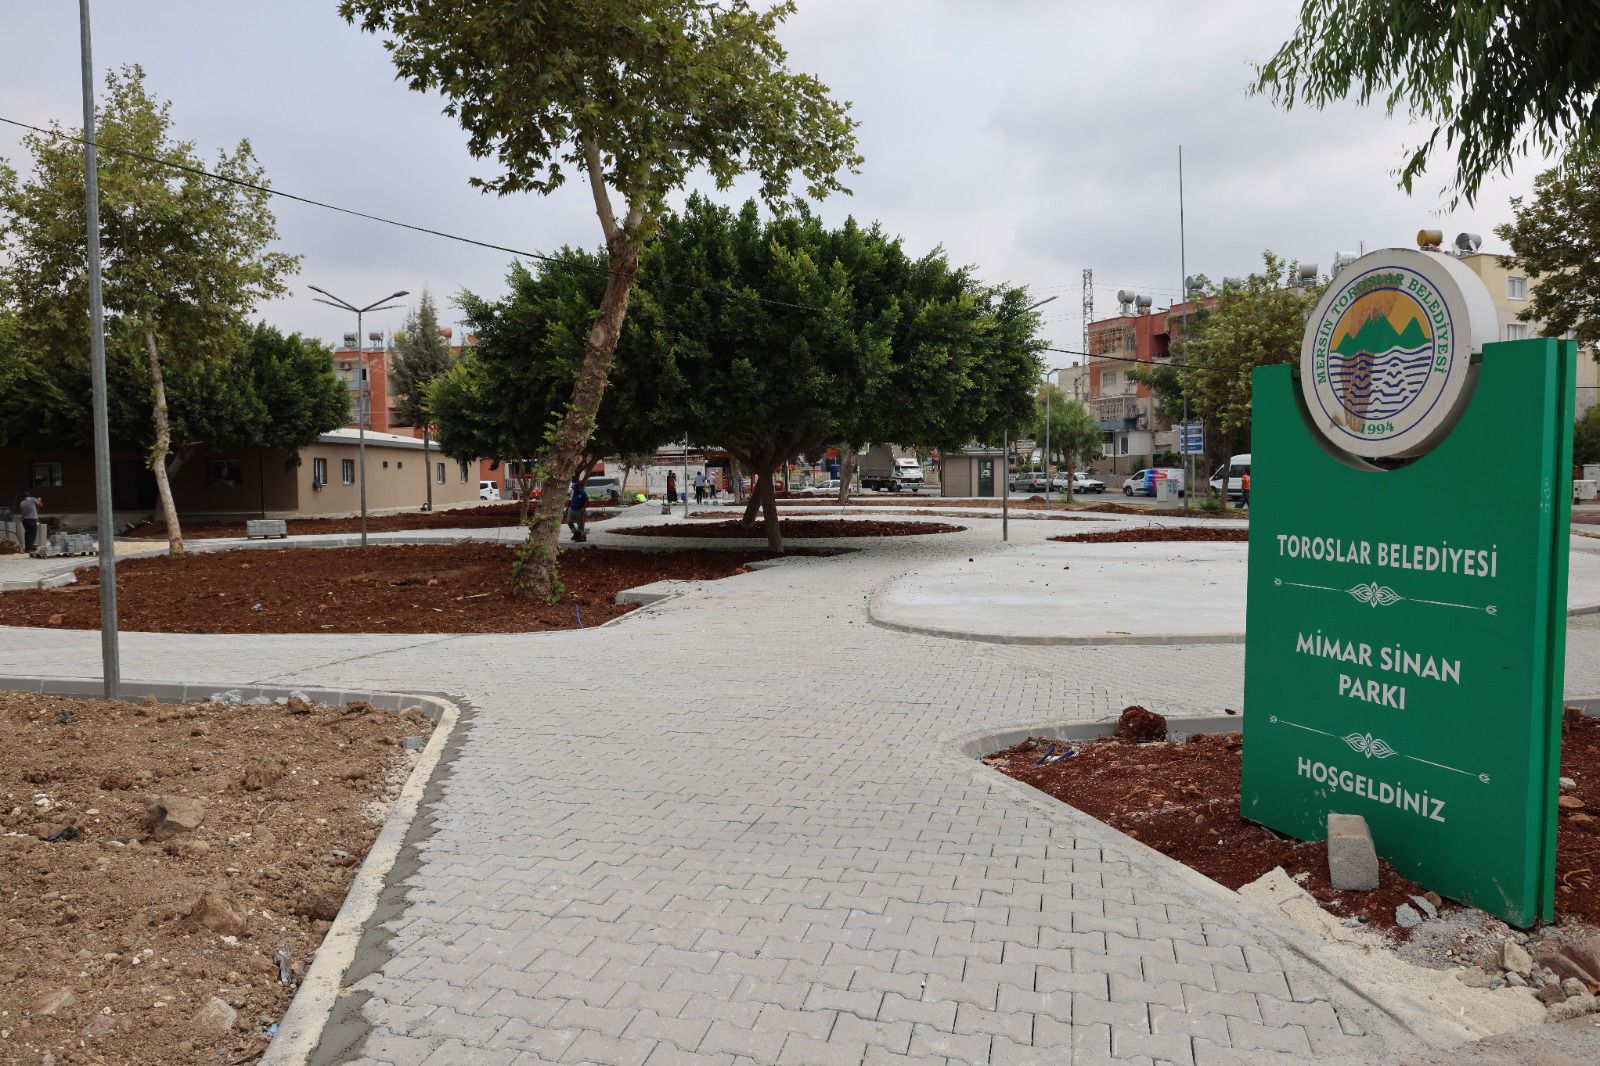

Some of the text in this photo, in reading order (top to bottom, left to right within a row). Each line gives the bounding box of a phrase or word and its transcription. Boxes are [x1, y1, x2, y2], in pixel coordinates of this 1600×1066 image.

[1315, 272, 1451, 385] MERSİN TOROSLAR BELEDİYESİ
[1360, 421, 1395, 435] 1994
[1276, 534, 1498, 578] TOROSLAR BELEDİYESİ
[1296, 629, 1462, 686] MİMAR SİNAN
[1338, 673, 1406, 711] PARKI
[1297, 756, 1447, 823] HOŞGELDİNİZ
